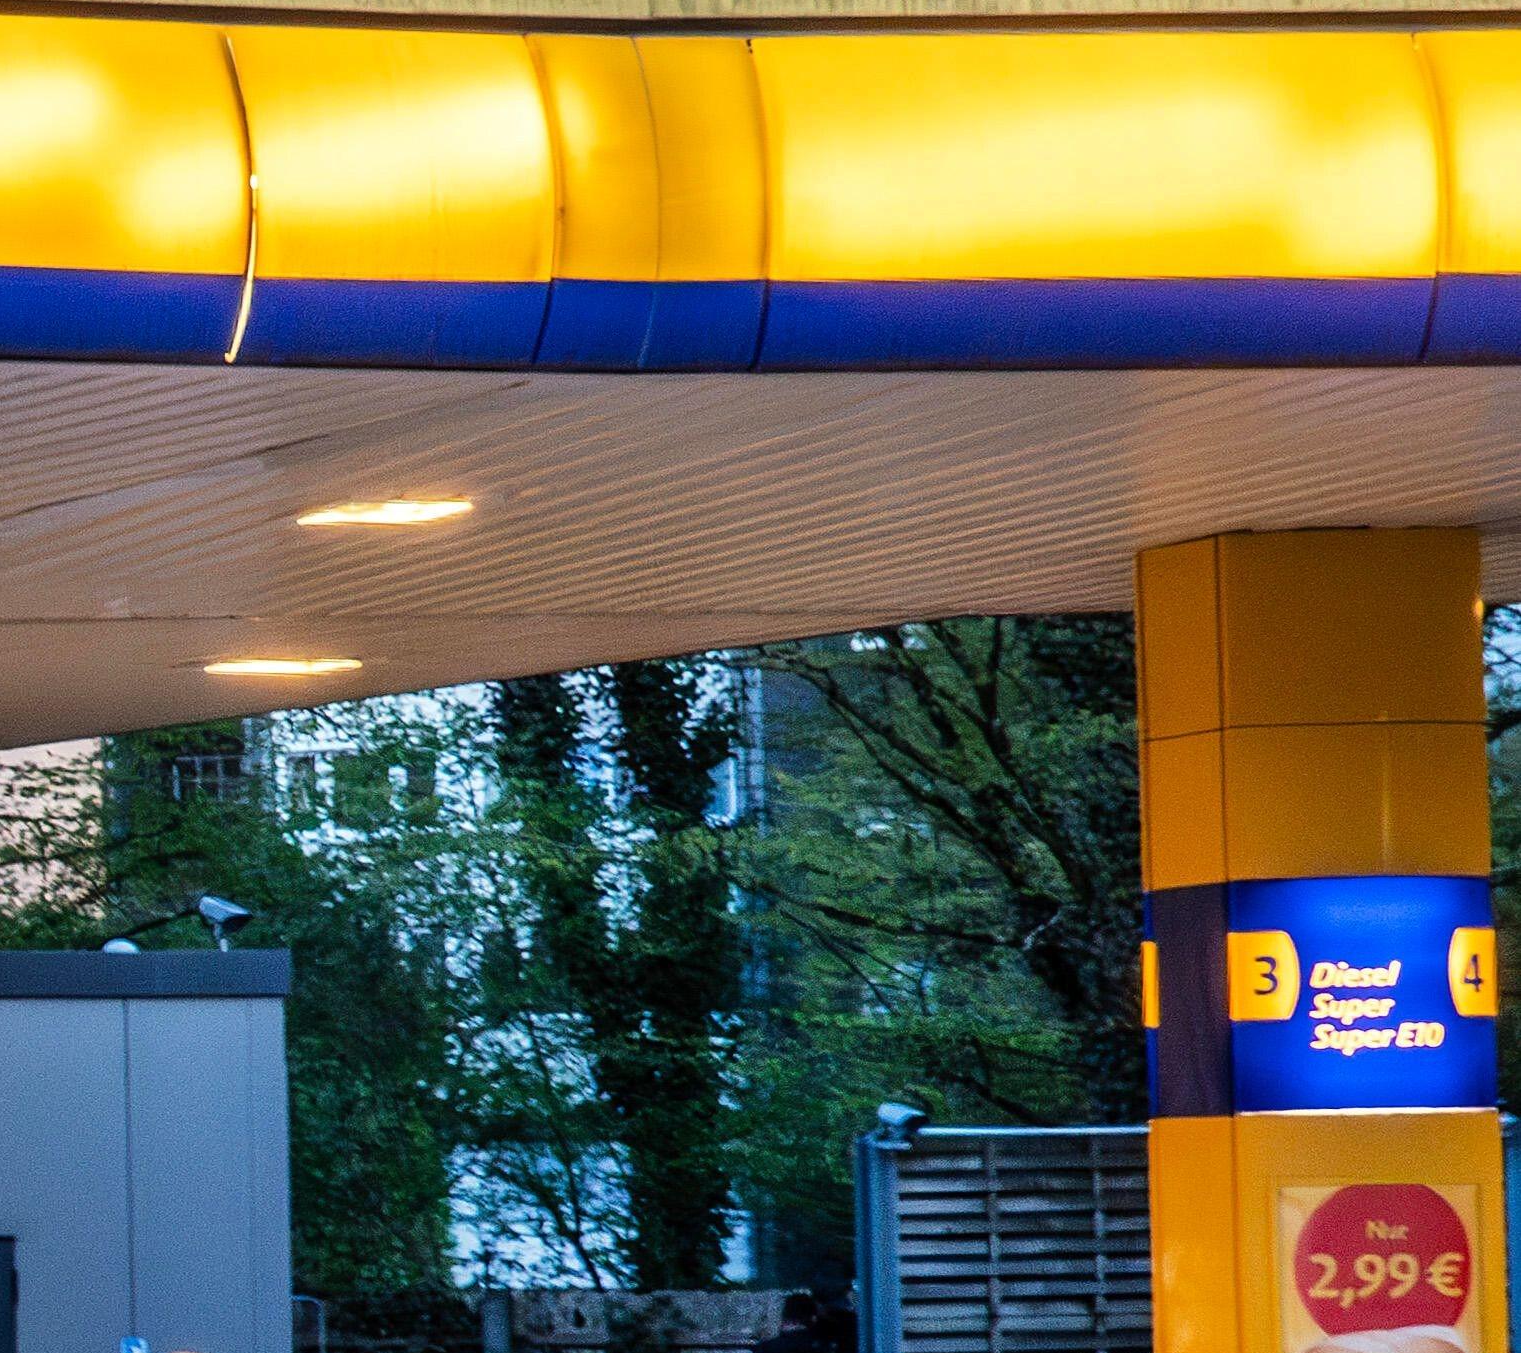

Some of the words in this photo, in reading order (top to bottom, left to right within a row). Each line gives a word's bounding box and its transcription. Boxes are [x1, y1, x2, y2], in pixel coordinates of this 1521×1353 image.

[1254, 956, 1278, 996] 3
[1309, 960, 1402, 989] Diesel
[1460, 953, 1484, 993] 4
[1309, 993, 1396, 1026] Super
[1309, 1023, 1396, 1056] Super
[1395, 1022, 1445, 1049] E10
